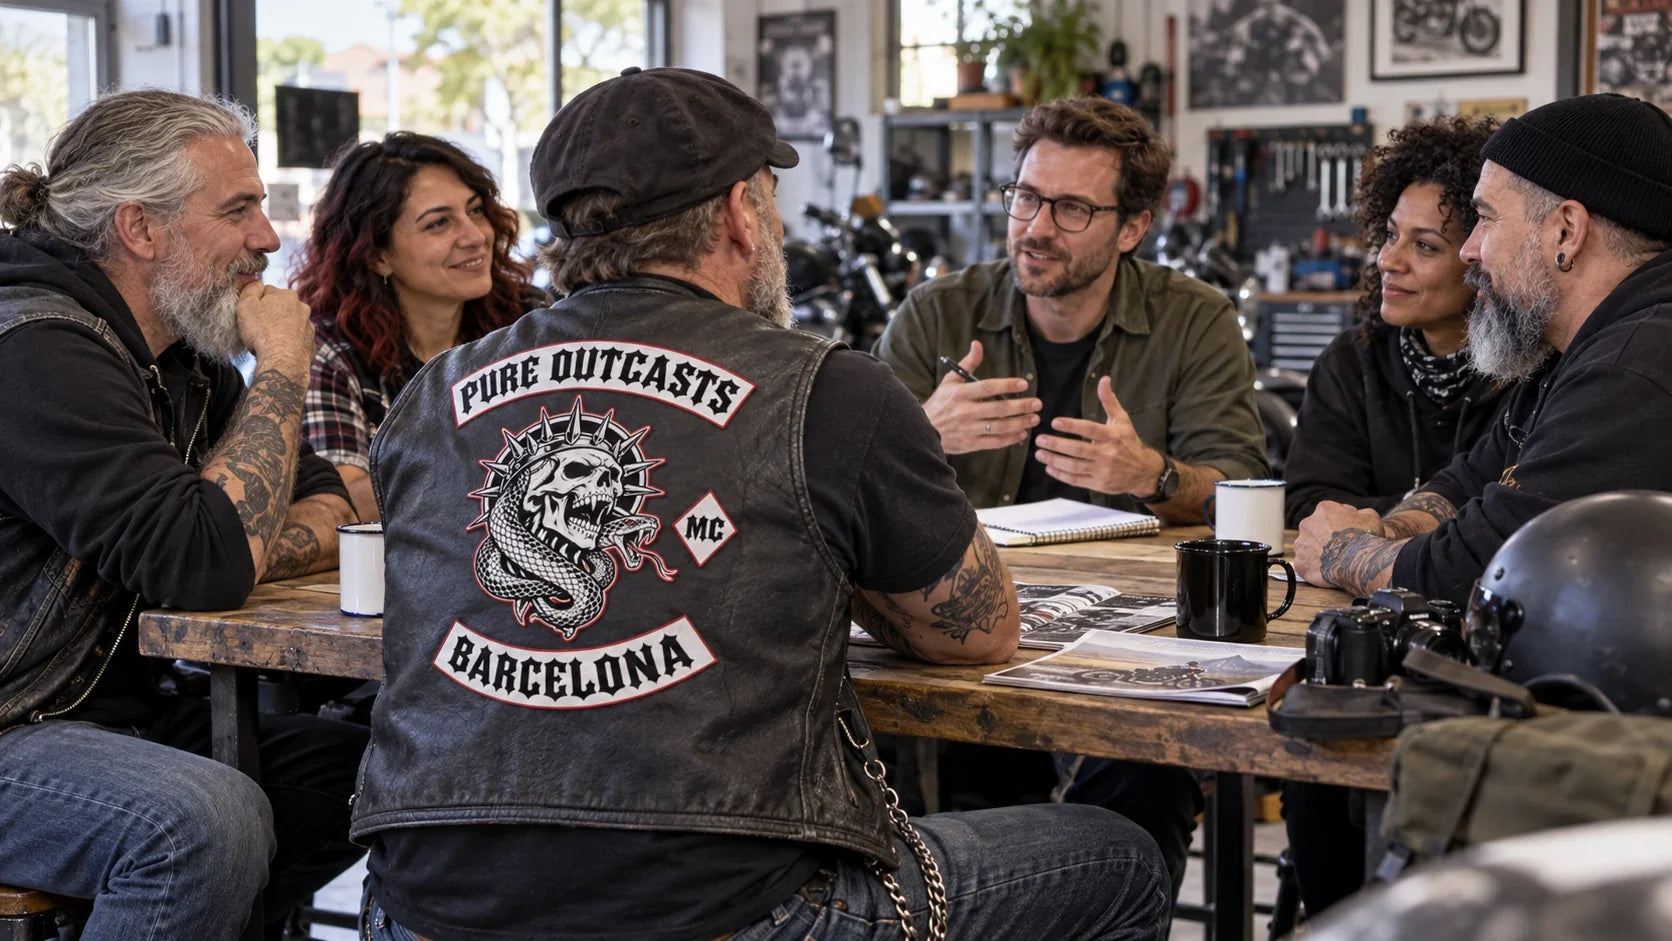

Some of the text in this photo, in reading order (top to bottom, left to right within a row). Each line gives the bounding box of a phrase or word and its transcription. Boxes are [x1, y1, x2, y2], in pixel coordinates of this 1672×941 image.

[461, 347, 740, 415] PURE OUTCASTS
[685, 515, 725, 542] MC
[448, 635, 694, 701] BARCELONA
